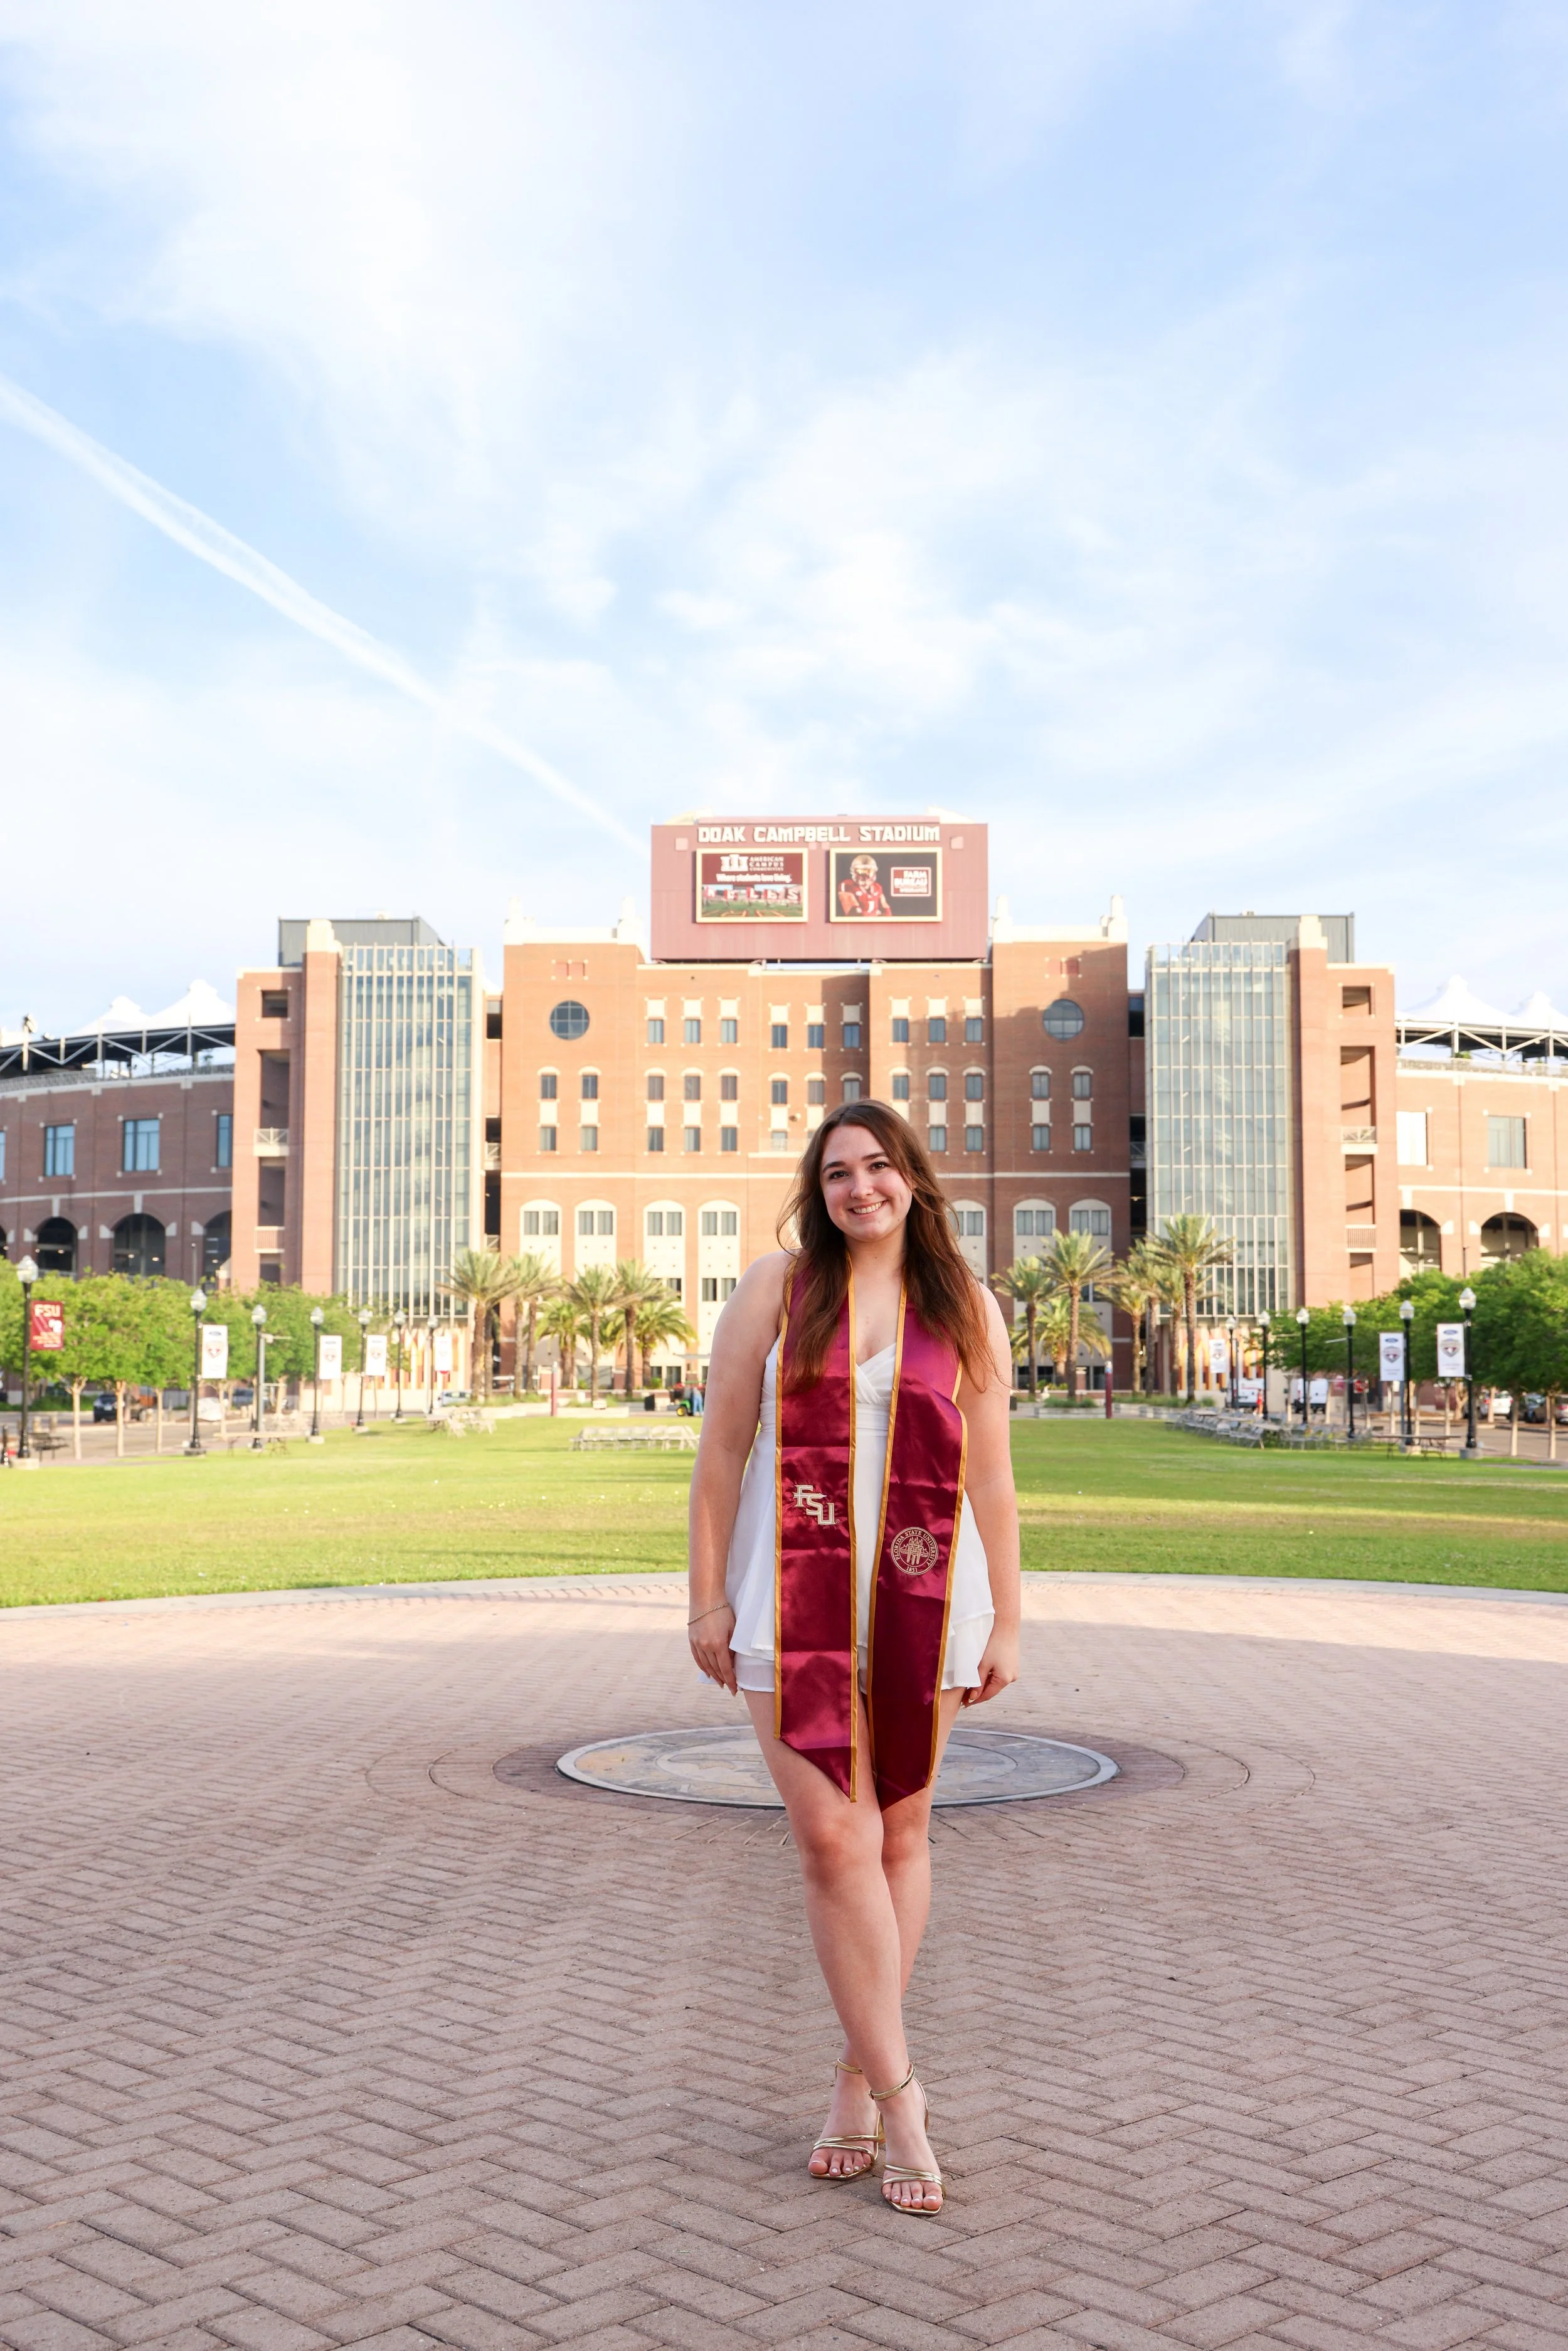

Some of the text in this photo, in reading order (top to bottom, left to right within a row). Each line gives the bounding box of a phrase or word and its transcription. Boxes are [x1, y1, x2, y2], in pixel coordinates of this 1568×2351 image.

[697, 826, 940, 842] DOAK CAMPBELL STADIUM
[894, 878, 928, 886] BUREAU
[34, 1304, 61, 1317] FSU
[792, 1484, 837, 1525] FSU
[894, 1536, 904, 1561] FLORIDA
[923, 1533, 935, 1566] UNIVERSITY
